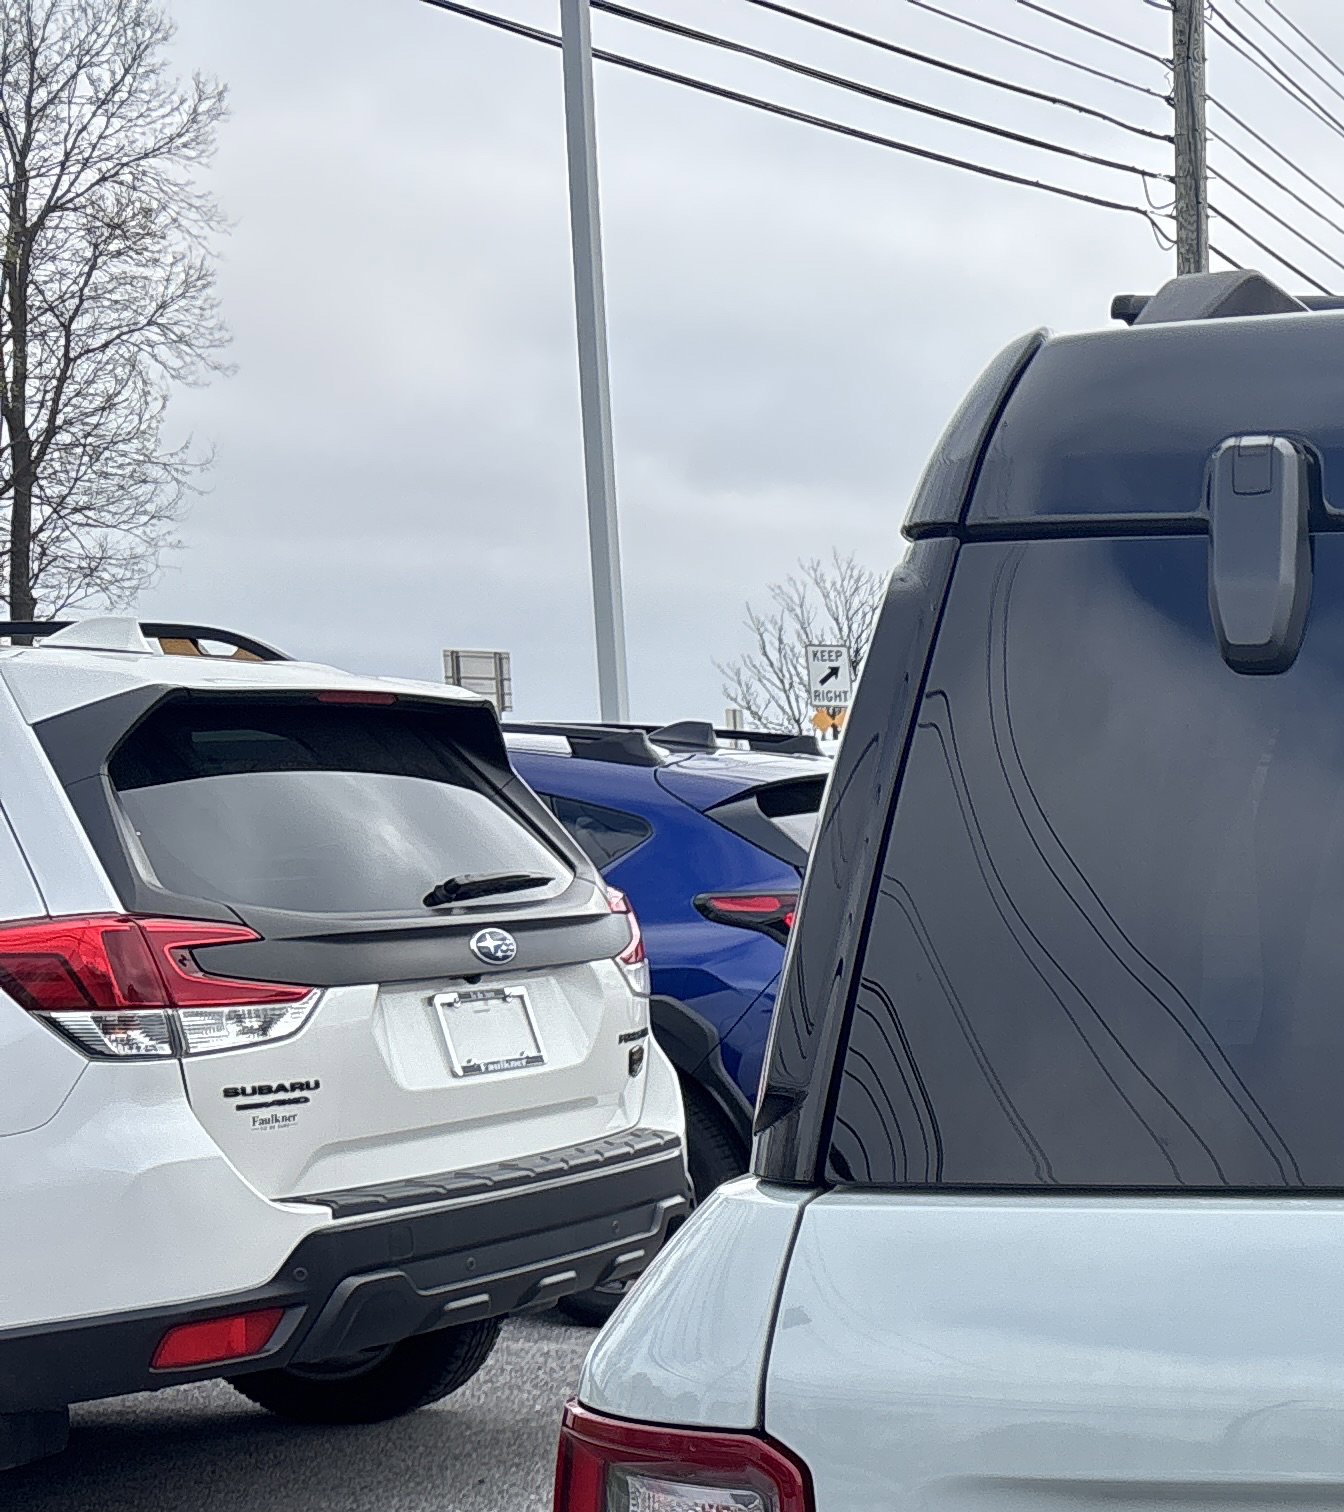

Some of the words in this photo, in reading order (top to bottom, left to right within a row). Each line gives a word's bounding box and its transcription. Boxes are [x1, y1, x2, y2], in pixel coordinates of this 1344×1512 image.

[812, 650, 843, 662] KEEP
[814, 690, 849, 702] RIGHT
[223, 1079, 320, 1098] SUBARU
[252, 1114, 298, 1127] Faulkner
